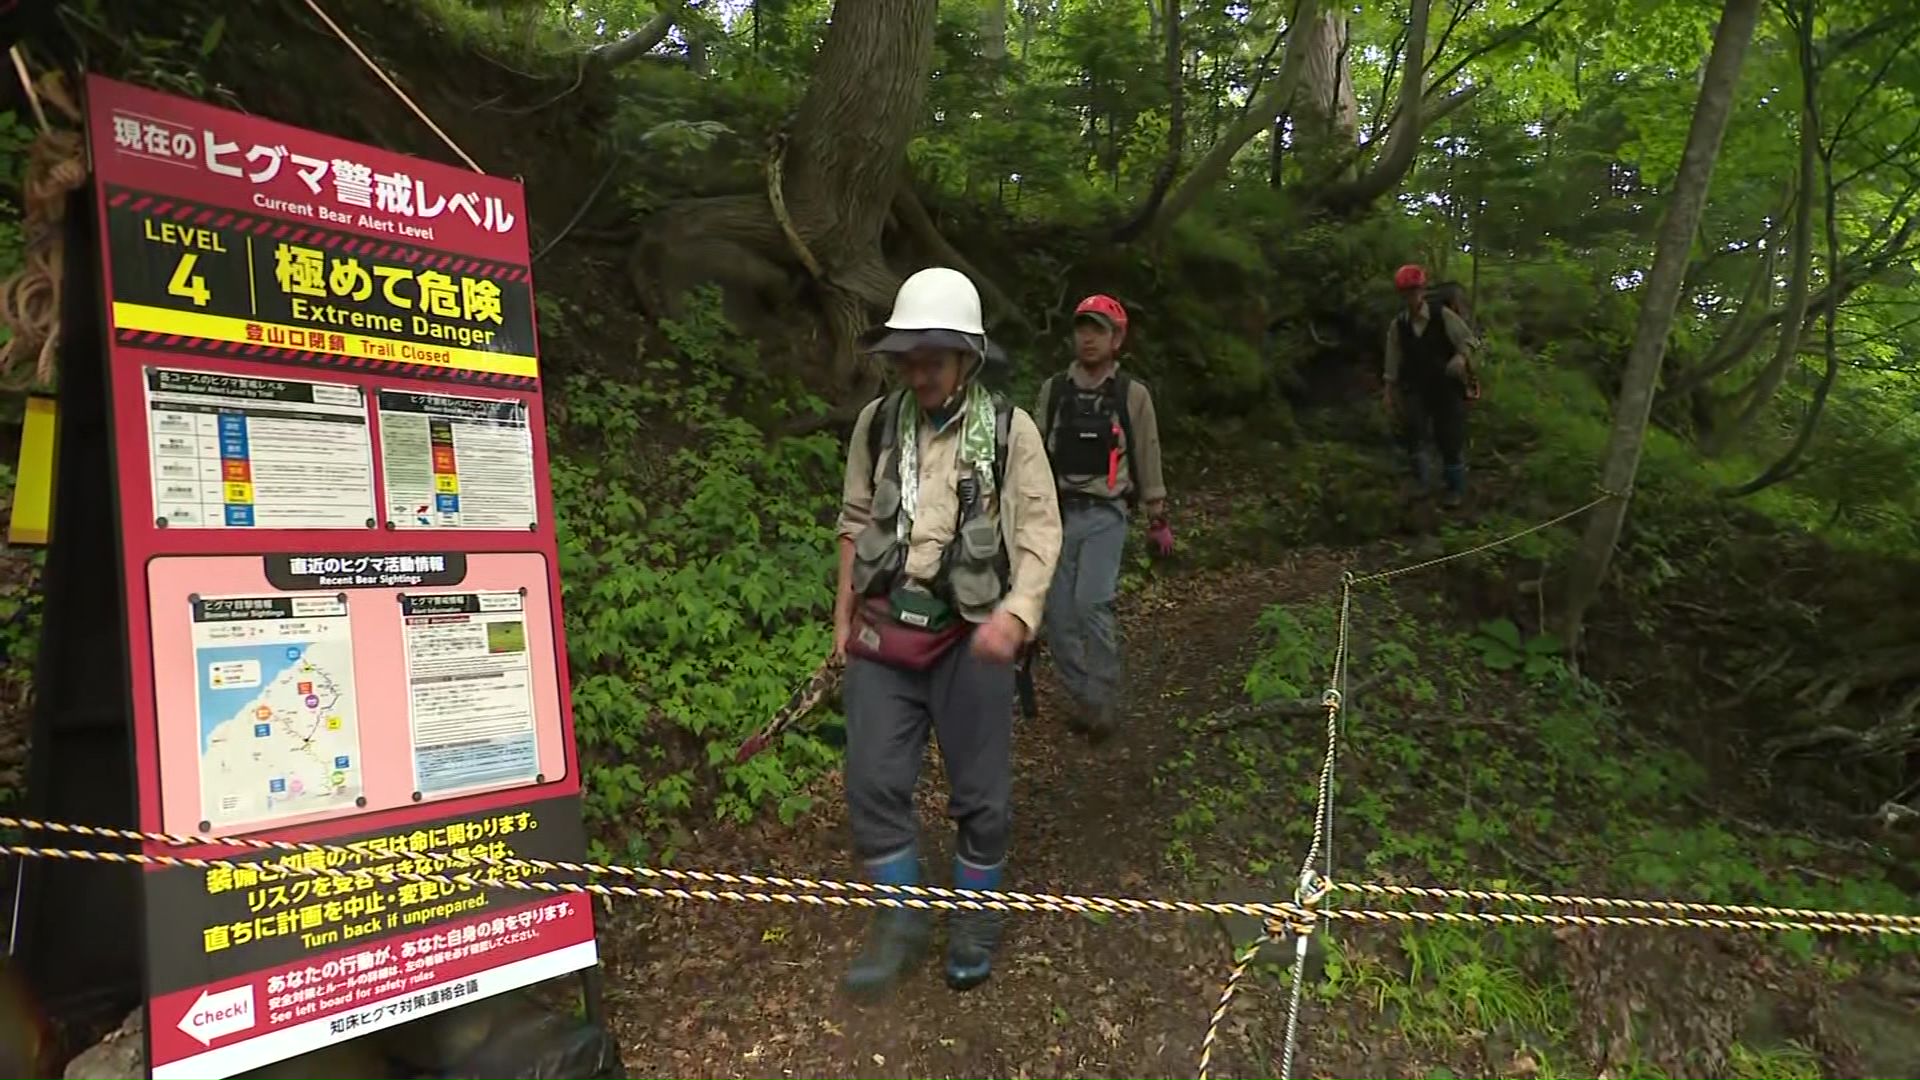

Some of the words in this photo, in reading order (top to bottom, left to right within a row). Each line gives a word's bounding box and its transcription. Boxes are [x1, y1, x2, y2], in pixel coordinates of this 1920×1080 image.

[144, 219, 227, 253] LEVEL
[253, 193, 313, 218] Current
[318, 206, 353, 226] Bear
[357, 214, 395, 234] Alert
[398, 222, 434, 241] Level
[167, 255, 211, 307] 4
[274, 242, 504, 326] 極めて危険
[245, 323, 346, 353] 登山口閉鎖
[360, 339, 396, 358] Trail
[401, 345, 450, 364] Closed
[292, 298, 403, 334] Extreme
[412, 315, 496, 347] Danger
[289, 556, 445, 575] 直近のヒグマ活動情報
[320, 576, 353, 586] Recent
[355, 575, 378, 585] Bear
[380, 574, 422, 586] Sightings
[301, 931, 338, 949] Turn
[343, 922, 382, 940] back
[387, 913, 399, 928] if
[403, 893, 490, 925] unprepared.
[267, 902, 576, 994] あなたの行動が、あなた自身の身を守ります。
[192, 1000, 248, 1027] Check!
[270, 1011, 292, 1024] See
[296, 1002, 317, 1017] left
[320, 991, 353, 1009] board
[356, 987, 372, 1001] for
[375, 978, 407, 995] safety
[410, 970, 435, 984] rules
[330, 978, 479, 1036] 知床ヒグマ対策連絡会議
